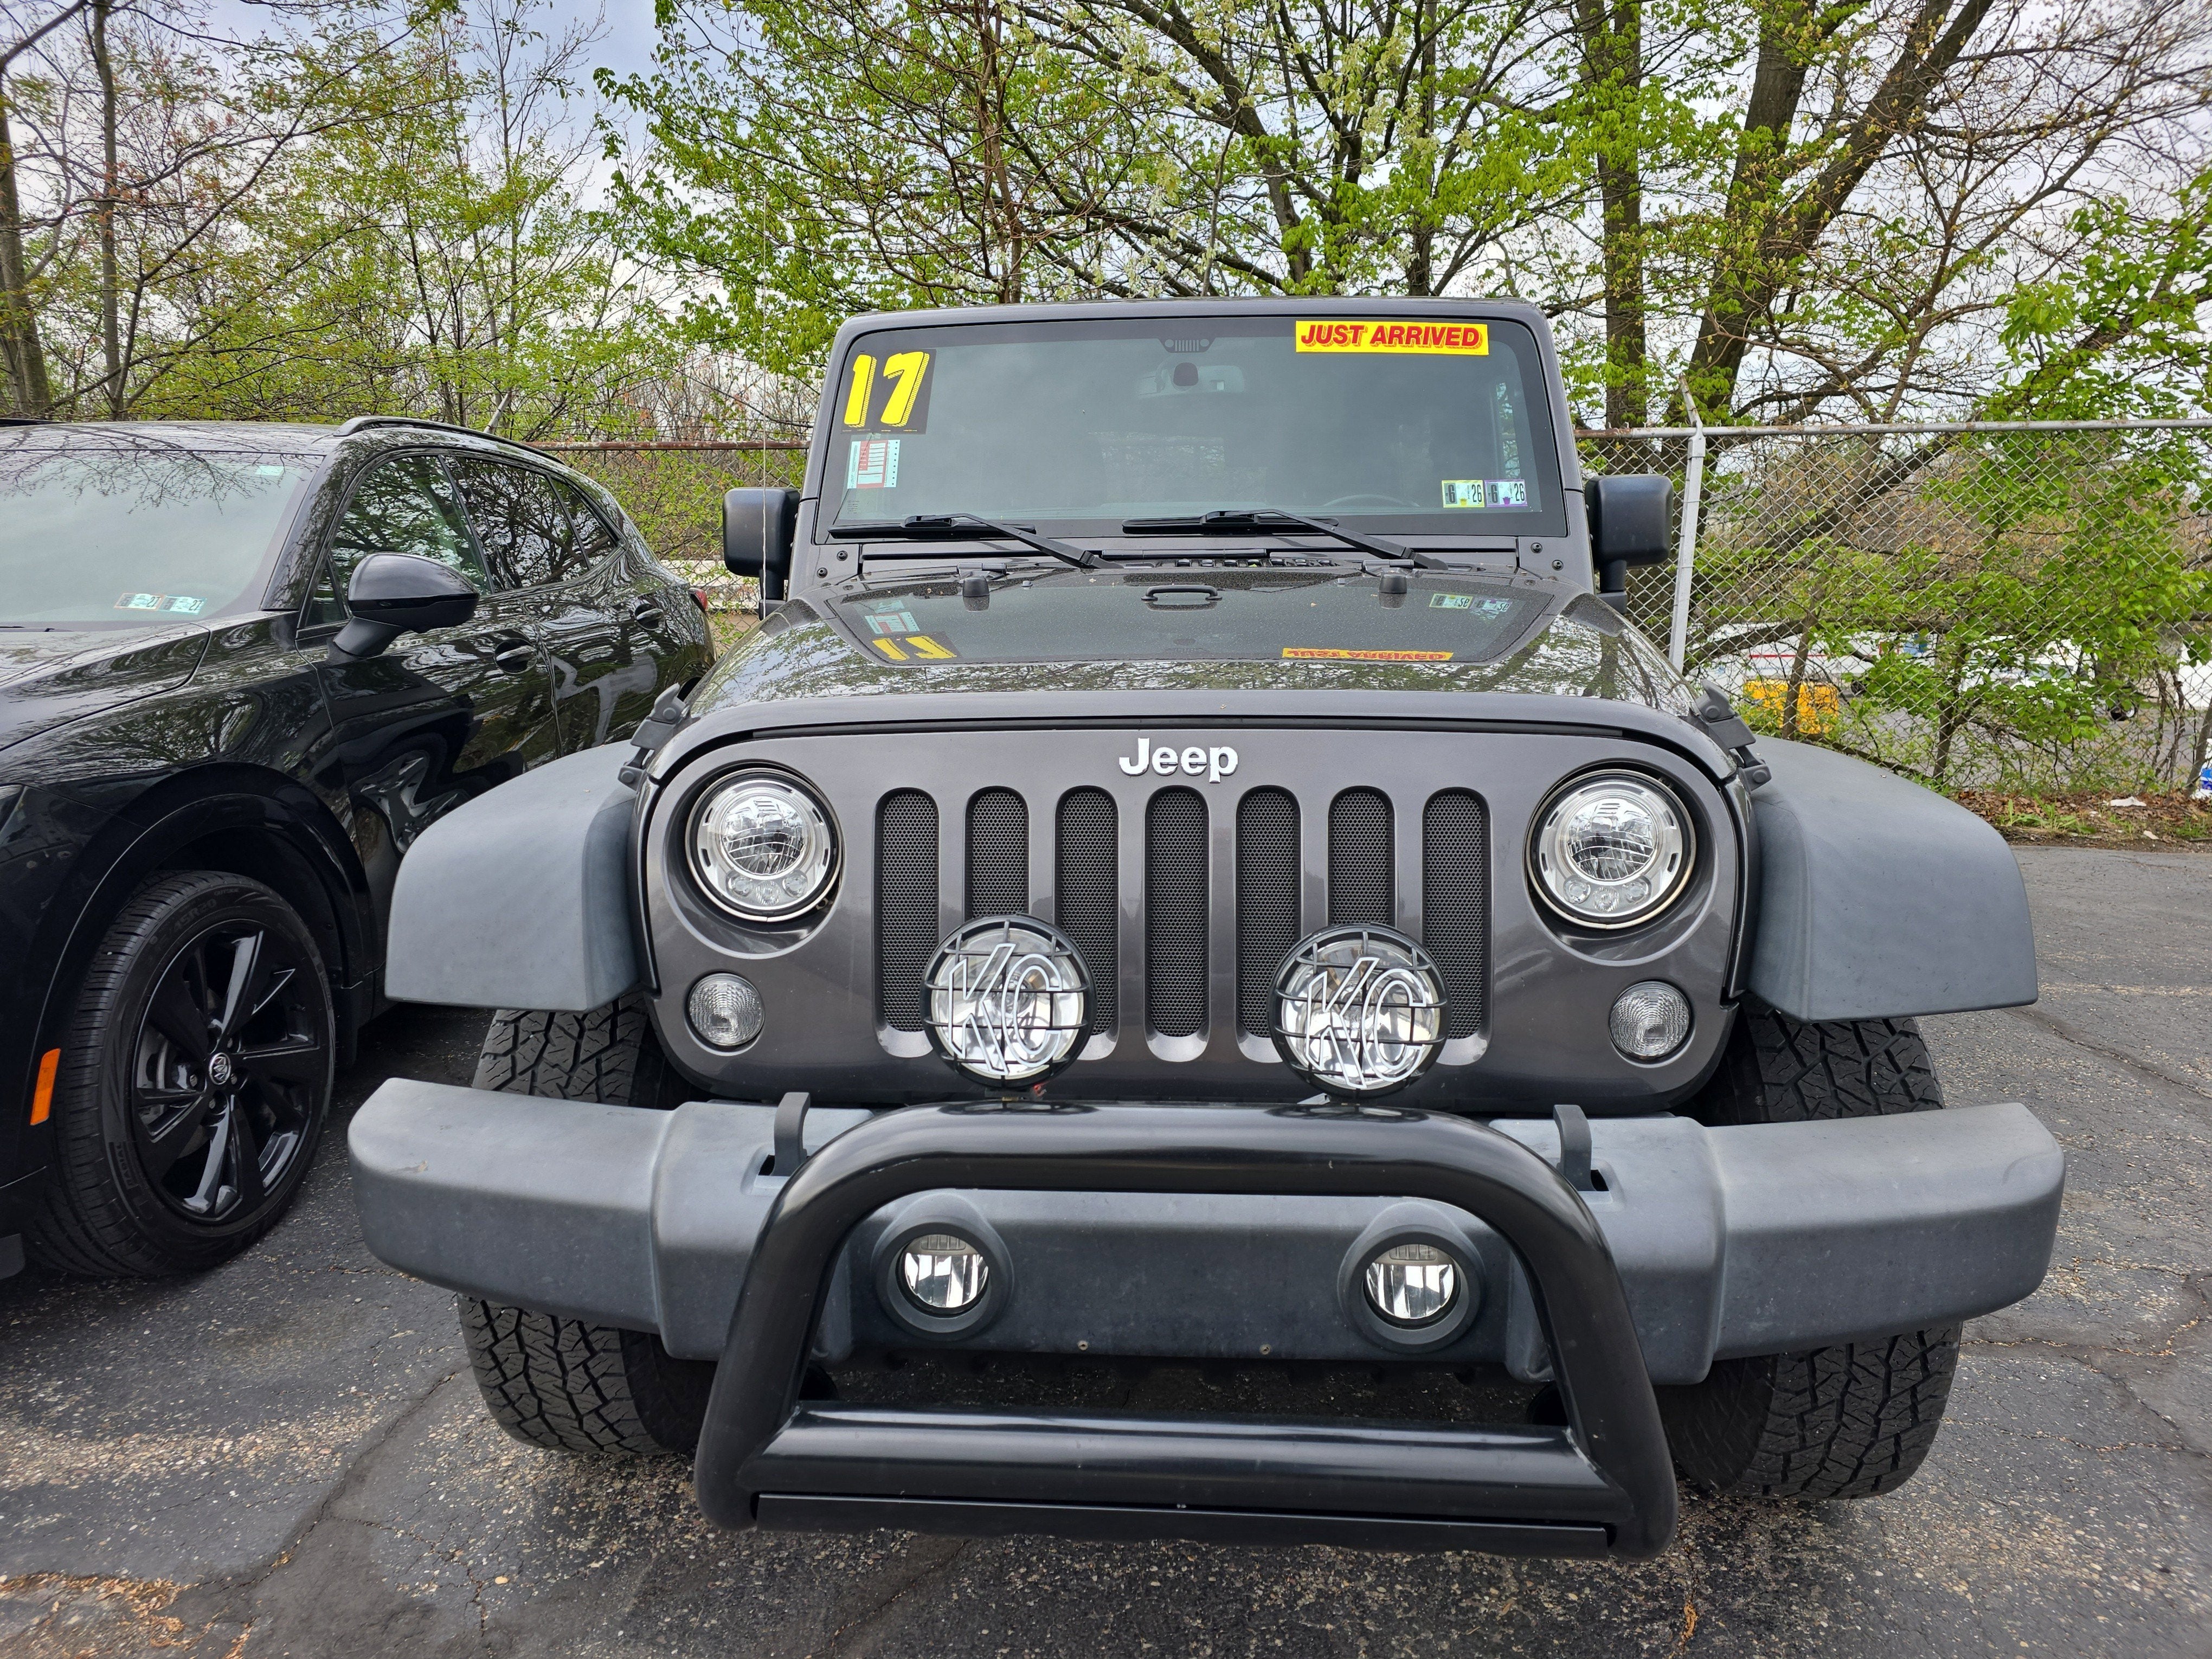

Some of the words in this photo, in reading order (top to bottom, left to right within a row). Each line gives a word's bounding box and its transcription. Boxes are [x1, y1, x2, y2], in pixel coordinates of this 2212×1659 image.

[1301, 325, 1368, 346] JUST
[1369, 325, 1483, 349] ARRIVED
[844, 351, 930, 428] 17
[1448, 484, 1456, 503] 6
[1471, 484, 1482, 503] 26
[1491, 484, 1499, 503] 6
[1514, 483, 1525, 501] 26
[146, 596, 160, 608] 27
[189, 600, 203, 611] 27
[1119, 738, 1238, 783] Jeep
[948, 943, 1063, 1075] KC
[1306, 957, 1427, 1089] KC
